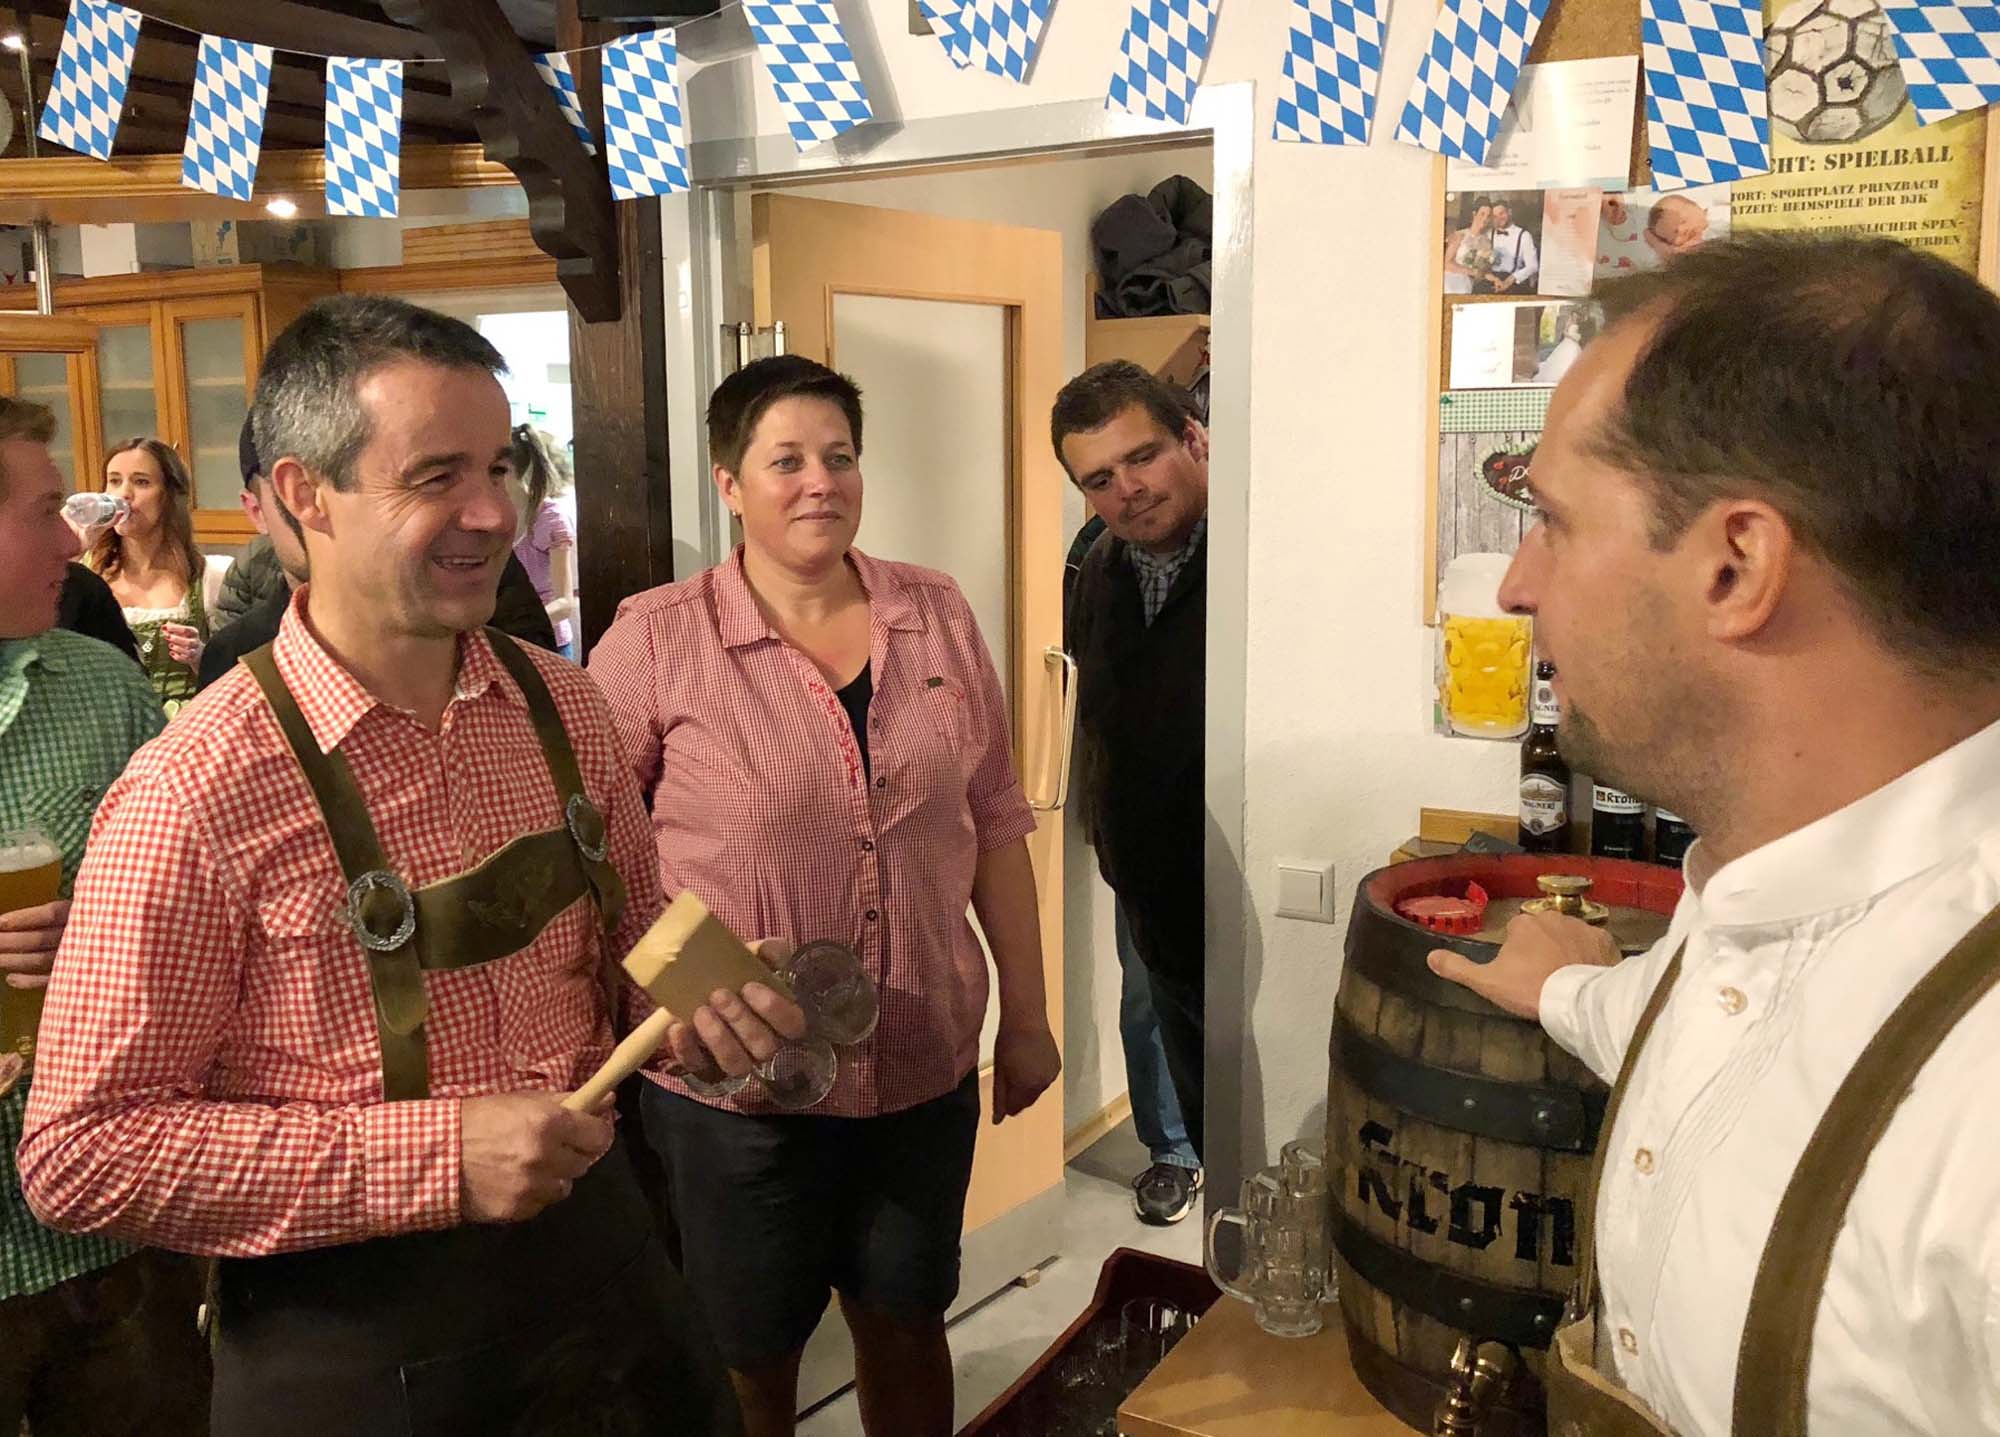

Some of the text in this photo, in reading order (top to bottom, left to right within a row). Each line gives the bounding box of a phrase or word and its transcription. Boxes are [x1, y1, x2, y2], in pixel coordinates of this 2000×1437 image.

[1824, 145, 1954, 171] SPIELBALL
[1771, 184, 1855, 200] SPORTPLATZ
[1859, 179, 1939, 194] PRINZBACH
[1783, 198, 1864, 213] HEIMSPIELE
[1868, 196, 1896, 208] DER
[1900, 193, 1929, 205] DJK
